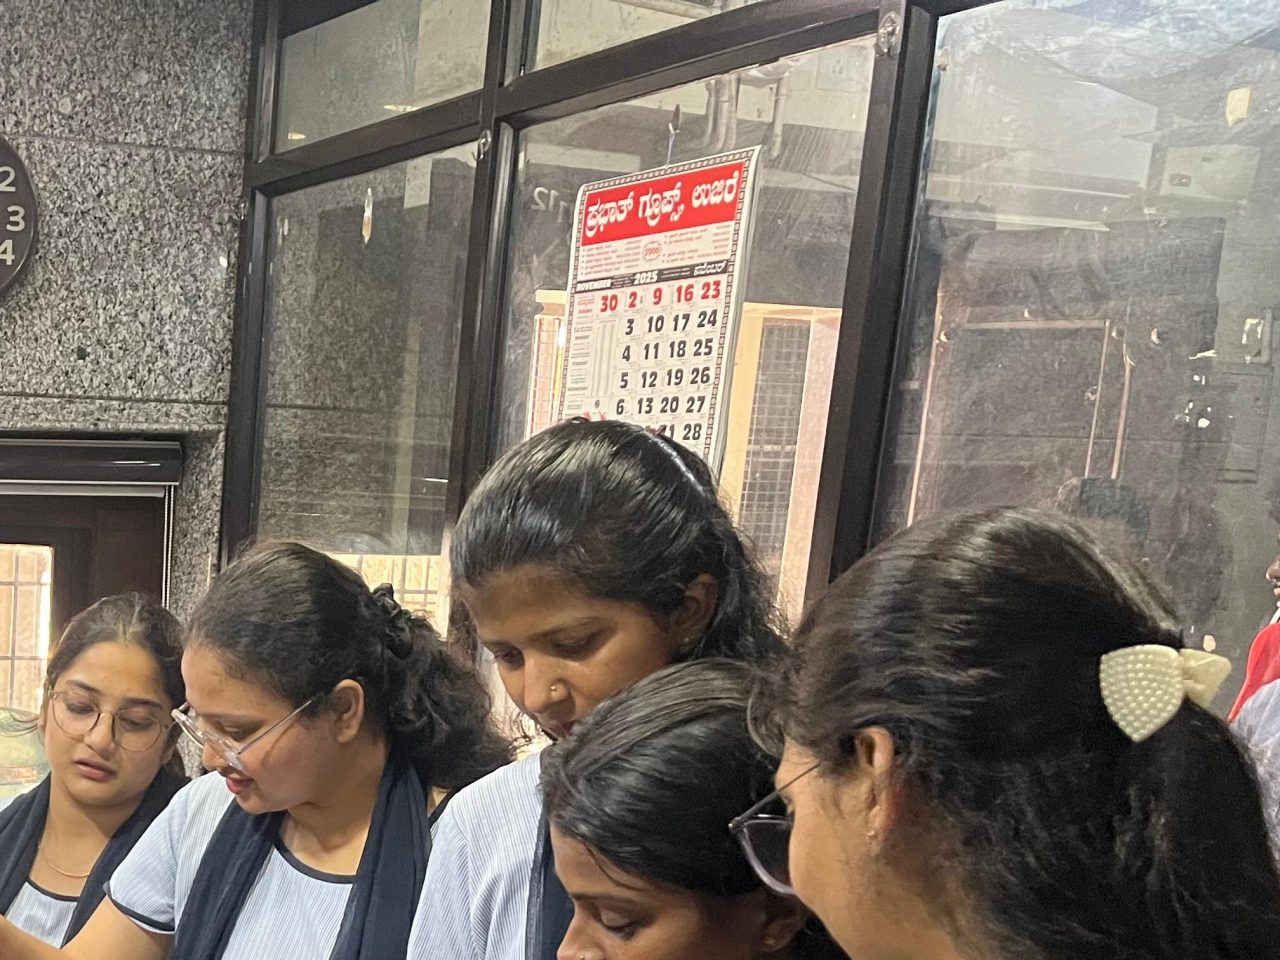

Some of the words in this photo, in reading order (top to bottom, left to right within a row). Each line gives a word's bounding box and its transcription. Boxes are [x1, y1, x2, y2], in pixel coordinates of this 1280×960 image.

[6, 205, 25, 231] 3
[634, 270, 659, 285] 2025
[600, 294, 618, 312] 30
[628, 291, 638, 309] 2
[653, 287, 663, 305] 9
[676, 284, 694, 303] 16
[701, 280, 721, 299] 23
[625, 318, 635, 336] 3
[647, 315, 665, 333] 10
[672, 313, 690, 332] 17
[697, 309, 718, 328] 24
[622, 345, 631, 362] 4
[643, 342, 660, 360] 11
[669, 340, 687, 359] 18
[693, 338, 714, 356] 25
[620, 372, 629, 389] 5
[641, 371, 658, 389] 12
[666, 368, 684, 386] 19
[690, 366, 711, 385] 26
[616, 399, 625, 415] 6
[637, 397, 654, 414] 13
[660, 396, 679, 414] 20
[685, 395, 706, 414] 27
[682, 423, 702, 441] 28
